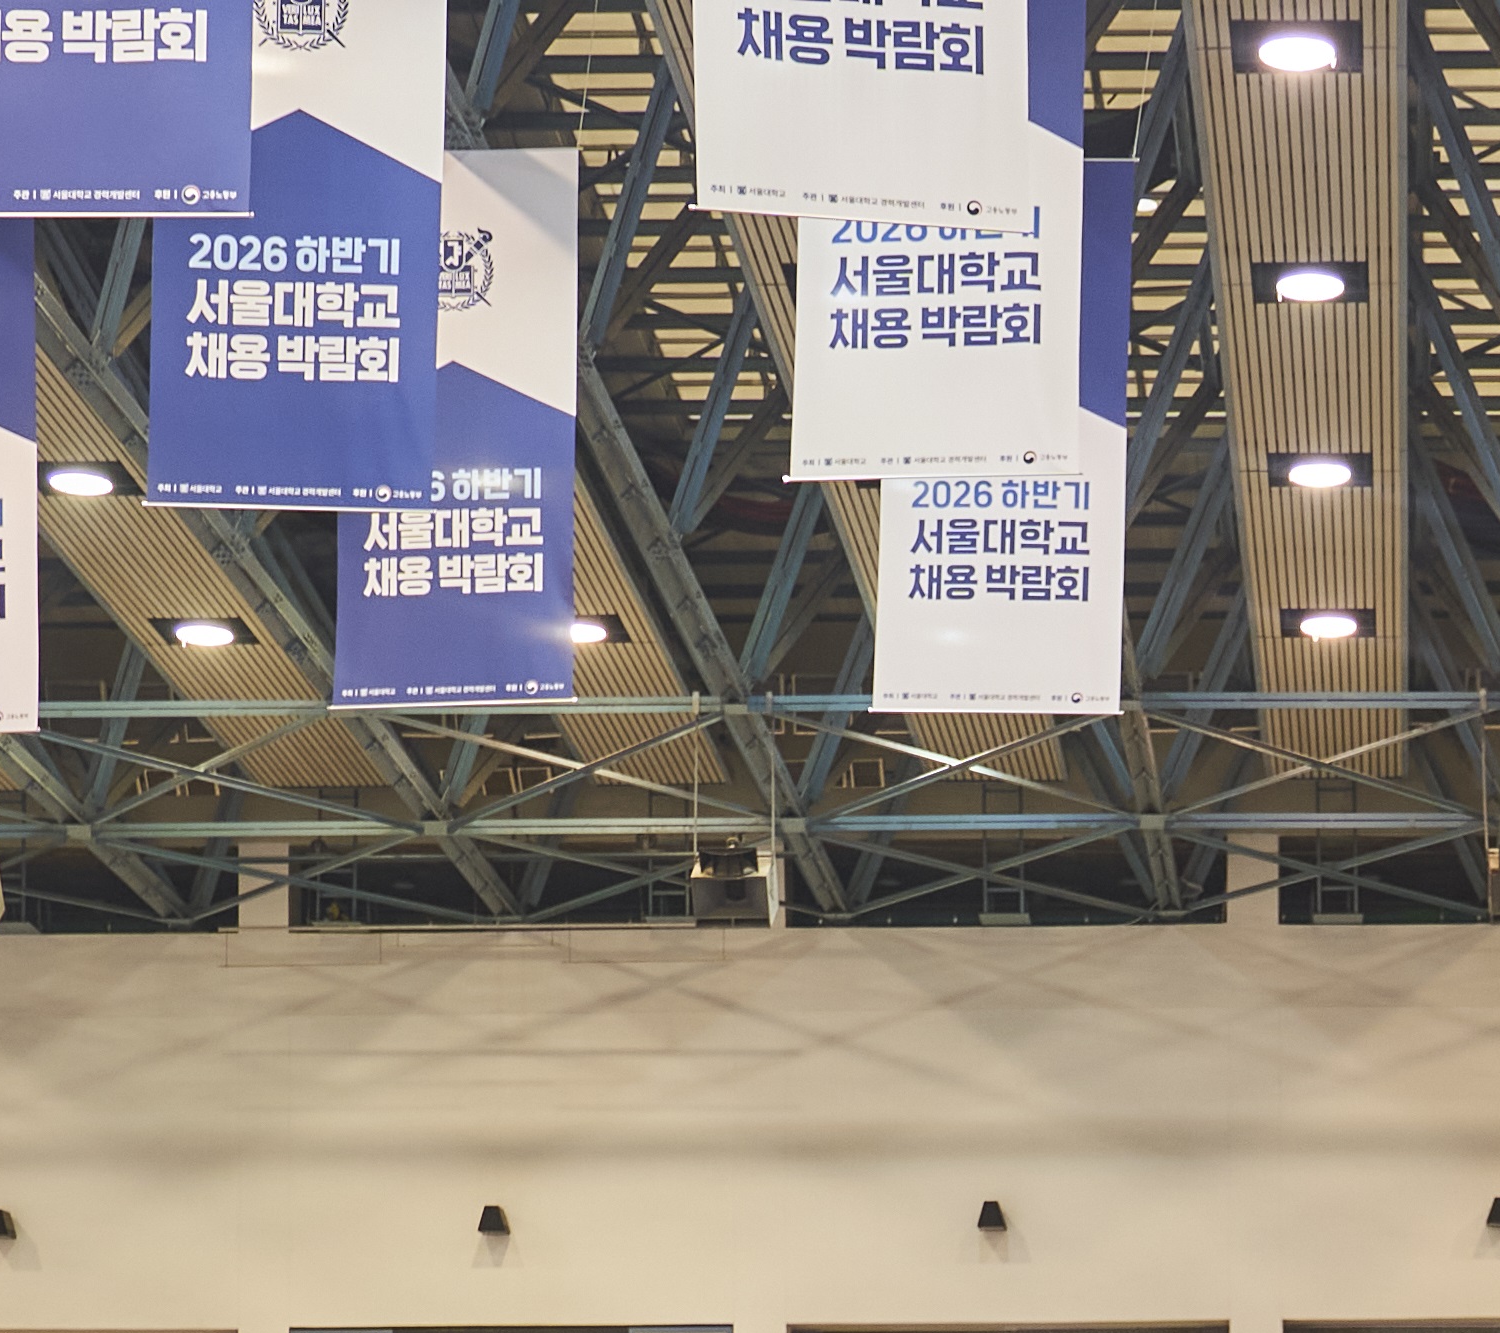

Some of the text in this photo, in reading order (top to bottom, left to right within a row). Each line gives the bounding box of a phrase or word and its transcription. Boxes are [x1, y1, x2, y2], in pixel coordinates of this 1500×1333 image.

[62, 8, 207, 63] 박람회
[738, 8, 983, 75] 채용 박람회
[189, 234, 399, 275] 2026 하반기
[831, 252, 1041, 295] 서울대학교
[187, 279, 400, 328] 서울대학교
[830, 303, 1041, 349] 채용 박람회
[185, 332, 399, 382] 채용 박람회
[452, 468, 541, 500] 하반기
[912, 480, 1089, 510] 2026 하반기
[364, 511, 543, 550] 서울대학교
[911, 519, 1089, 555] 서울대학교
[364, 553, 543, 597] 채용 박람회
[909, 564, 1089, 601] 채용 박람회
